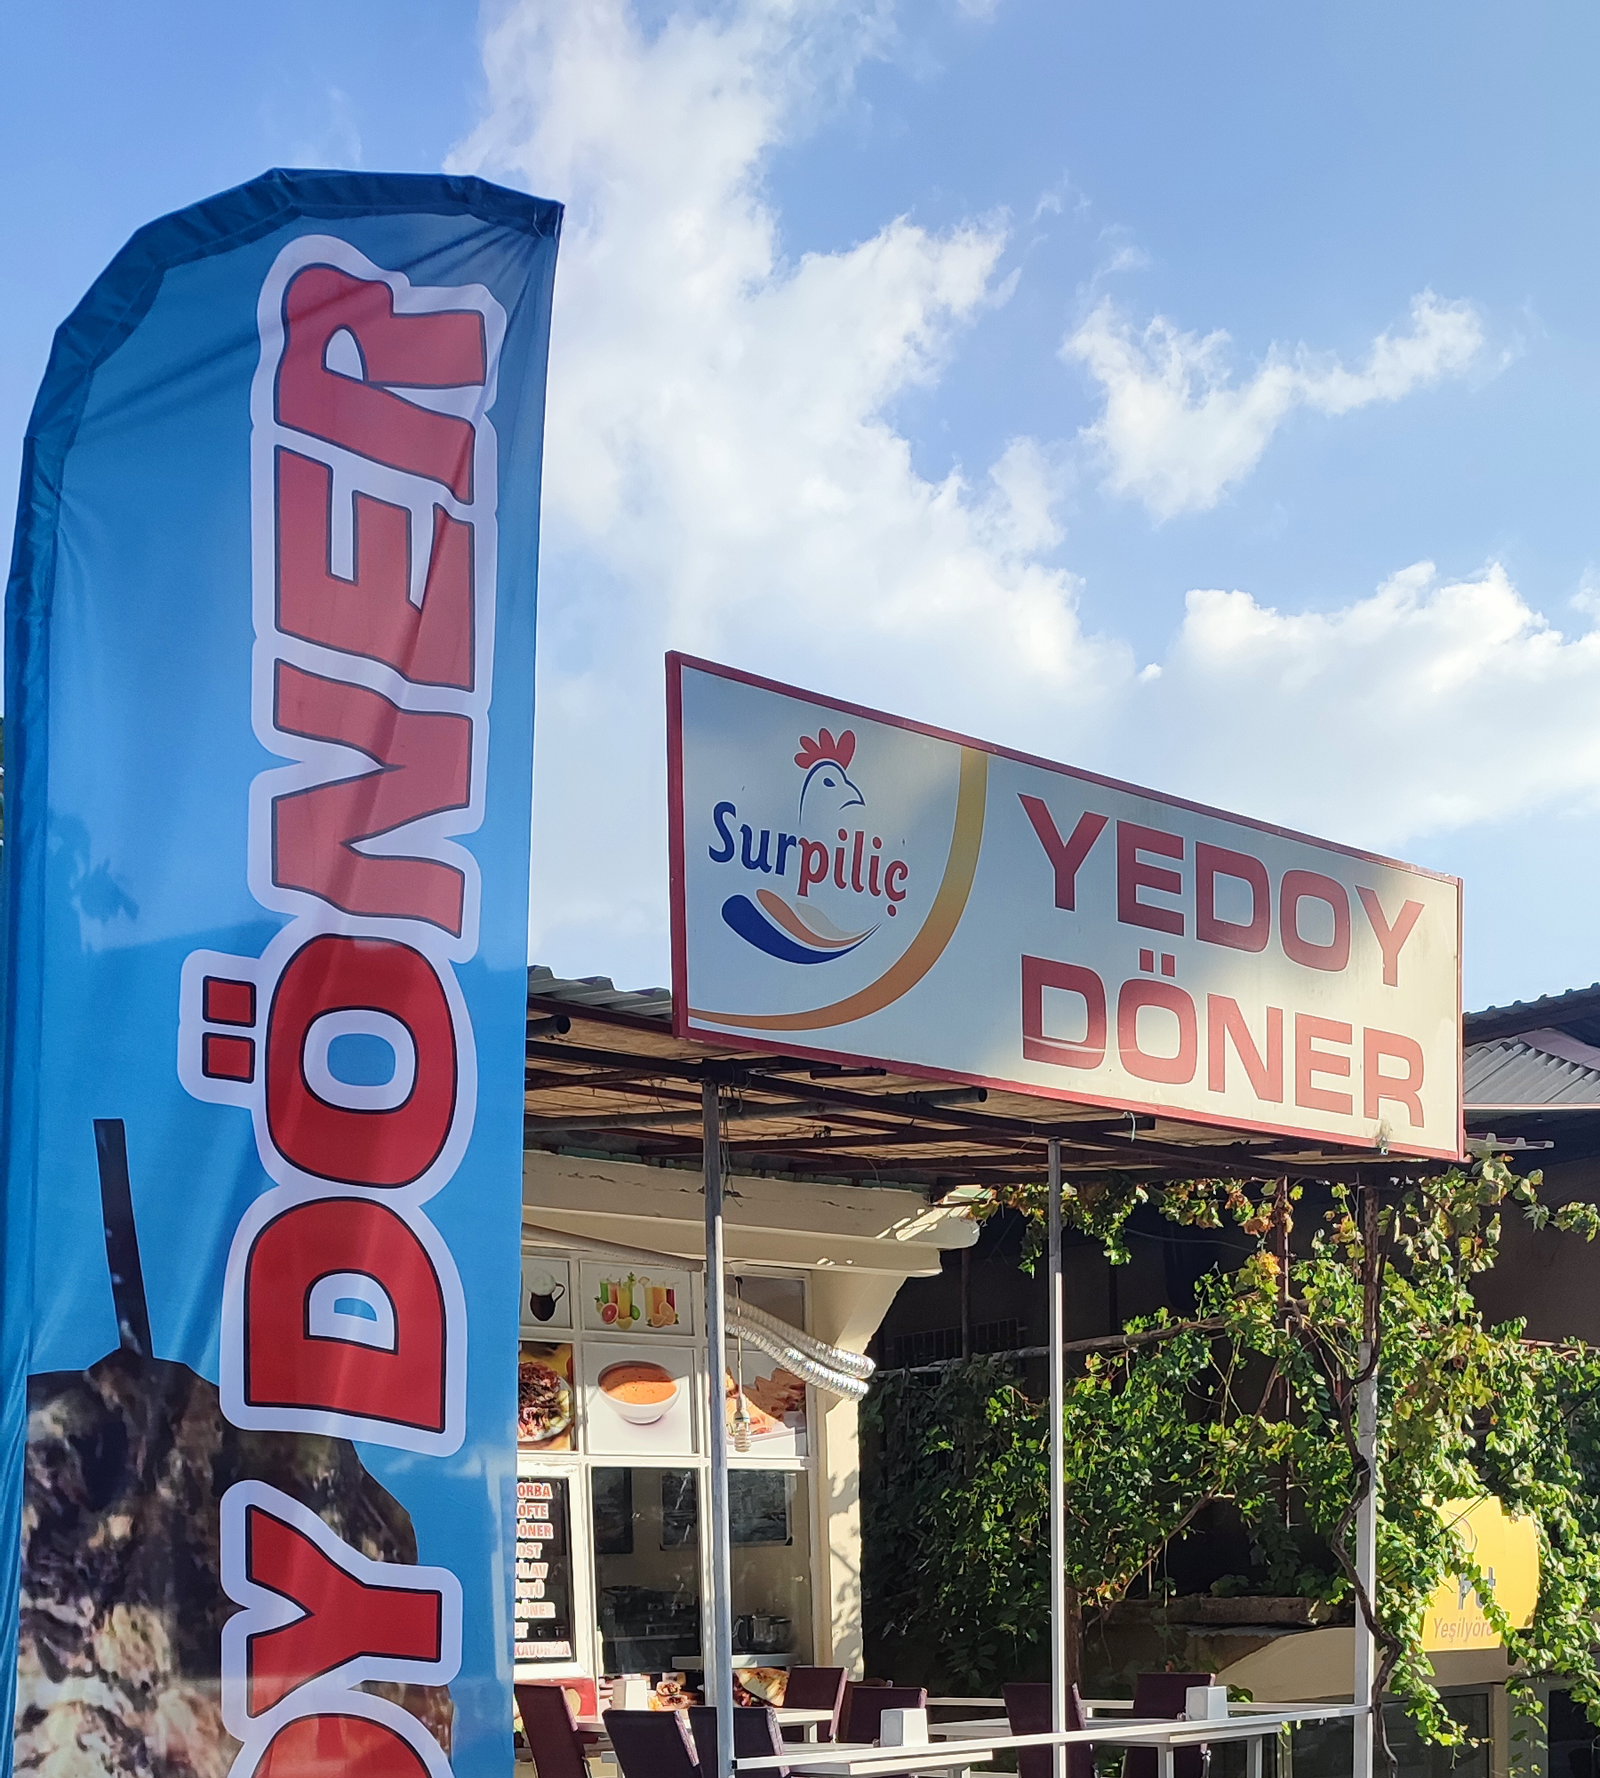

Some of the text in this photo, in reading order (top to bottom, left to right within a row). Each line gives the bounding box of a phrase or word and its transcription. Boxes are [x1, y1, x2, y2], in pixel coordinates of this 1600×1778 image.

[202, 261, 488, 1434] DÖNER
[708, 801, 910, 917] Surpiliç
[1017, 792, 1426, 987] YEDOY
[1020, 947, 1426, 1128] DÖNER
[516, 1482, 552, 1499] ORBA
[516, 1500, 549, 1518] ÖFTE
[516, 1520, 553, 1538] ÖNER
[516, 1542, 542, 1558] OST
[515, 1560, 549, 1578] İLAV
